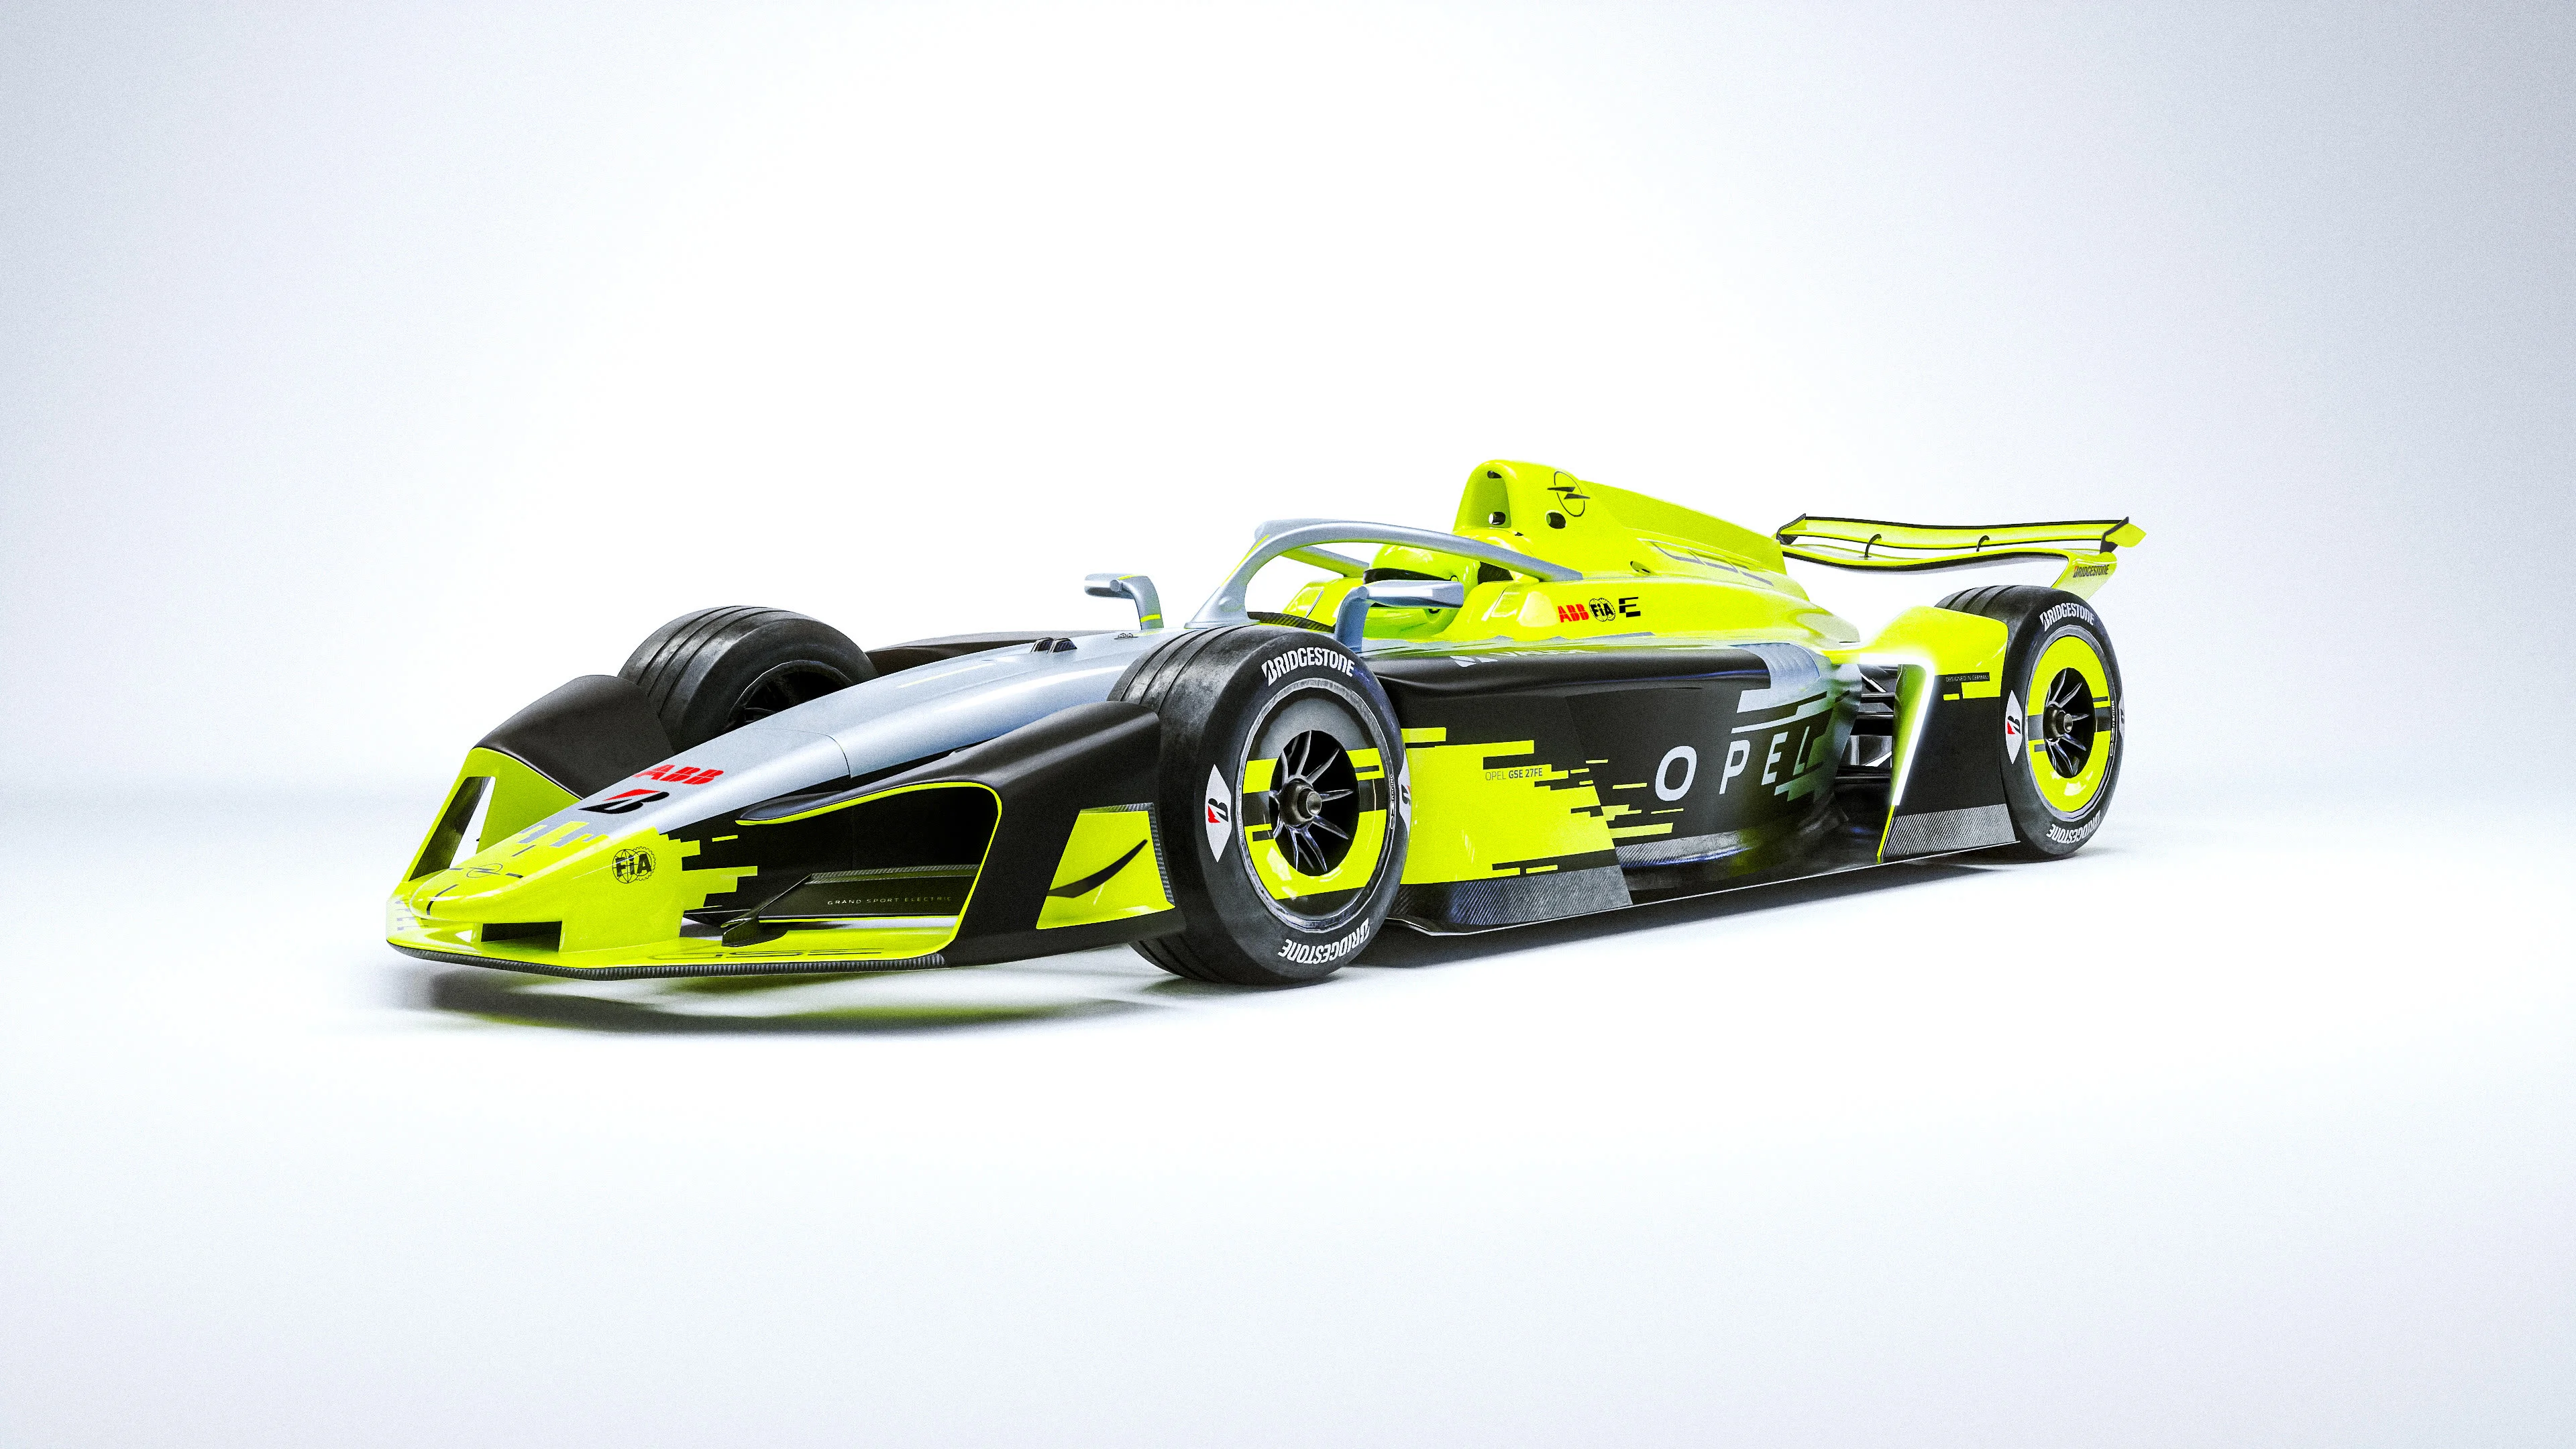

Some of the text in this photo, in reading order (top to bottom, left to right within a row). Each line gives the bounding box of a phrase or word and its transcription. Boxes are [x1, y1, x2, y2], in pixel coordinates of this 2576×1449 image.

[2073, 564, 2110, 578] BRIDGESTONE
[1557, 604, 1589, 623] ABB
[2039, 602, 2094, 632] BRIDGESTONE
[1261, 647, 1355, 687] BRIDGESTONE
[631, 764, 724, 785] ABB
[1485, 767, 1543, 781] OPEL GSE 27FE
[1655, 726, 1810, 802] OPEL
[2046, 810, 2100, 844] BRIDGESTONE
[1277, 917, 1370, 965] BRIDGESTONE
